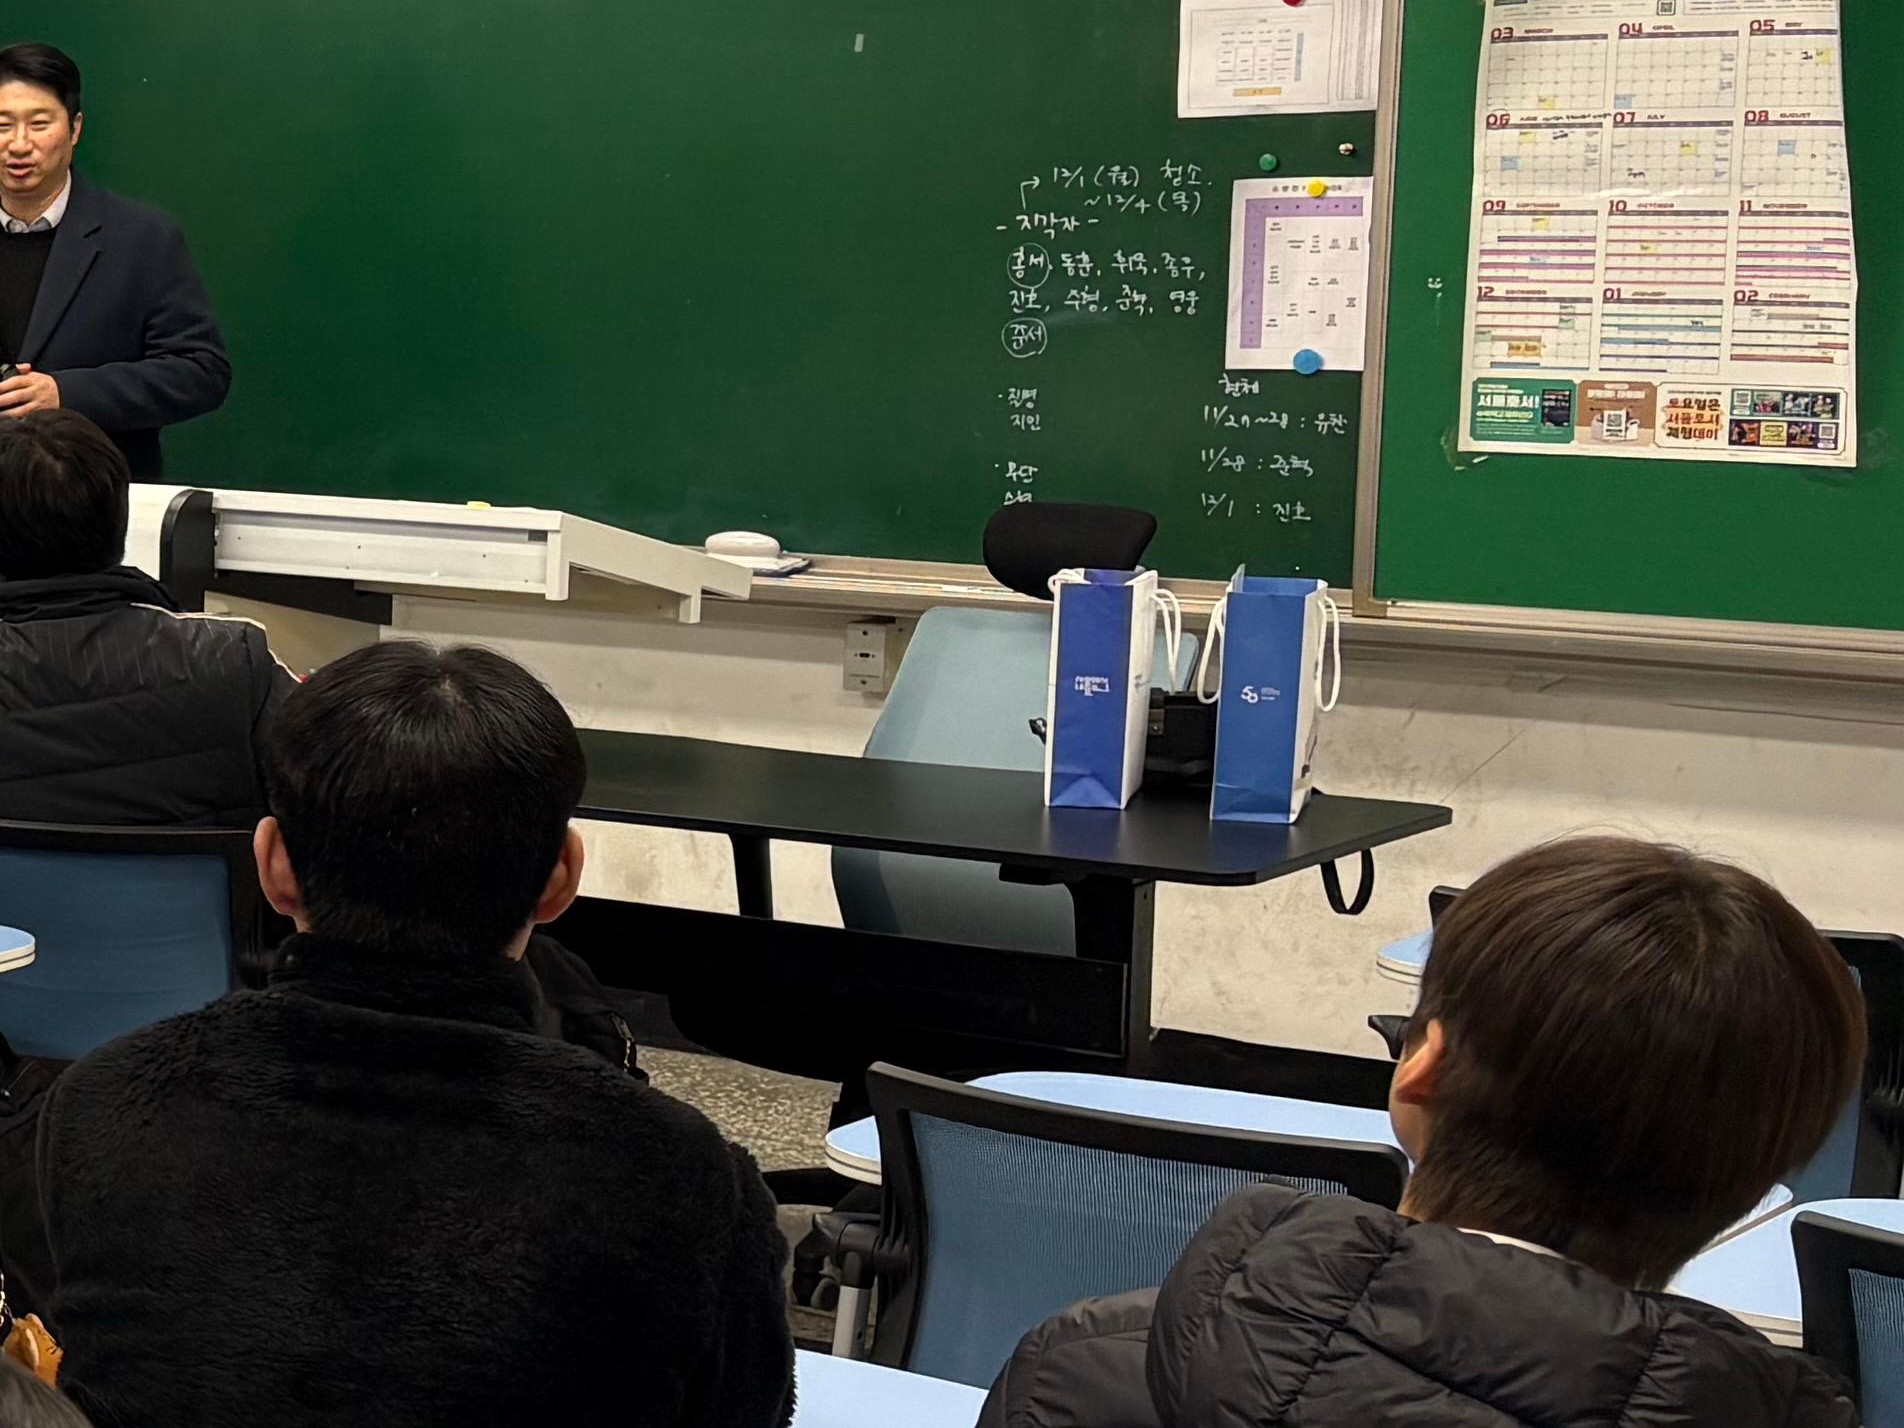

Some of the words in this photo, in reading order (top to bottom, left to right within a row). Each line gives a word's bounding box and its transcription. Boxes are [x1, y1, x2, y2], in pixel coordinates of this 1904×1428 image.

[1619, 23, 1643, 38] 04
[1750, 20, 1775, 32] 05
[1491, 27, 1514, 42] 03
[1486, 113, 1510, 127] 06
[1613, 112, 1636, 124] 07
[1745, 110, 1769, 123] 08
[1053, 166, 1084, 188] 12/1
[1483, 200, 1506, 213] 09
[1608, 200, 1627, 213] 10
[1740, 200, 1752, 213] 11
[1478, 286, 1495, 298] 12
[1603, 288, 1621, 301] 01
[1733, 290, 1759, 303] 02
[1201, 446, 1246, 472] 11/28
[1201, 493, 1234, 517] 12/1
